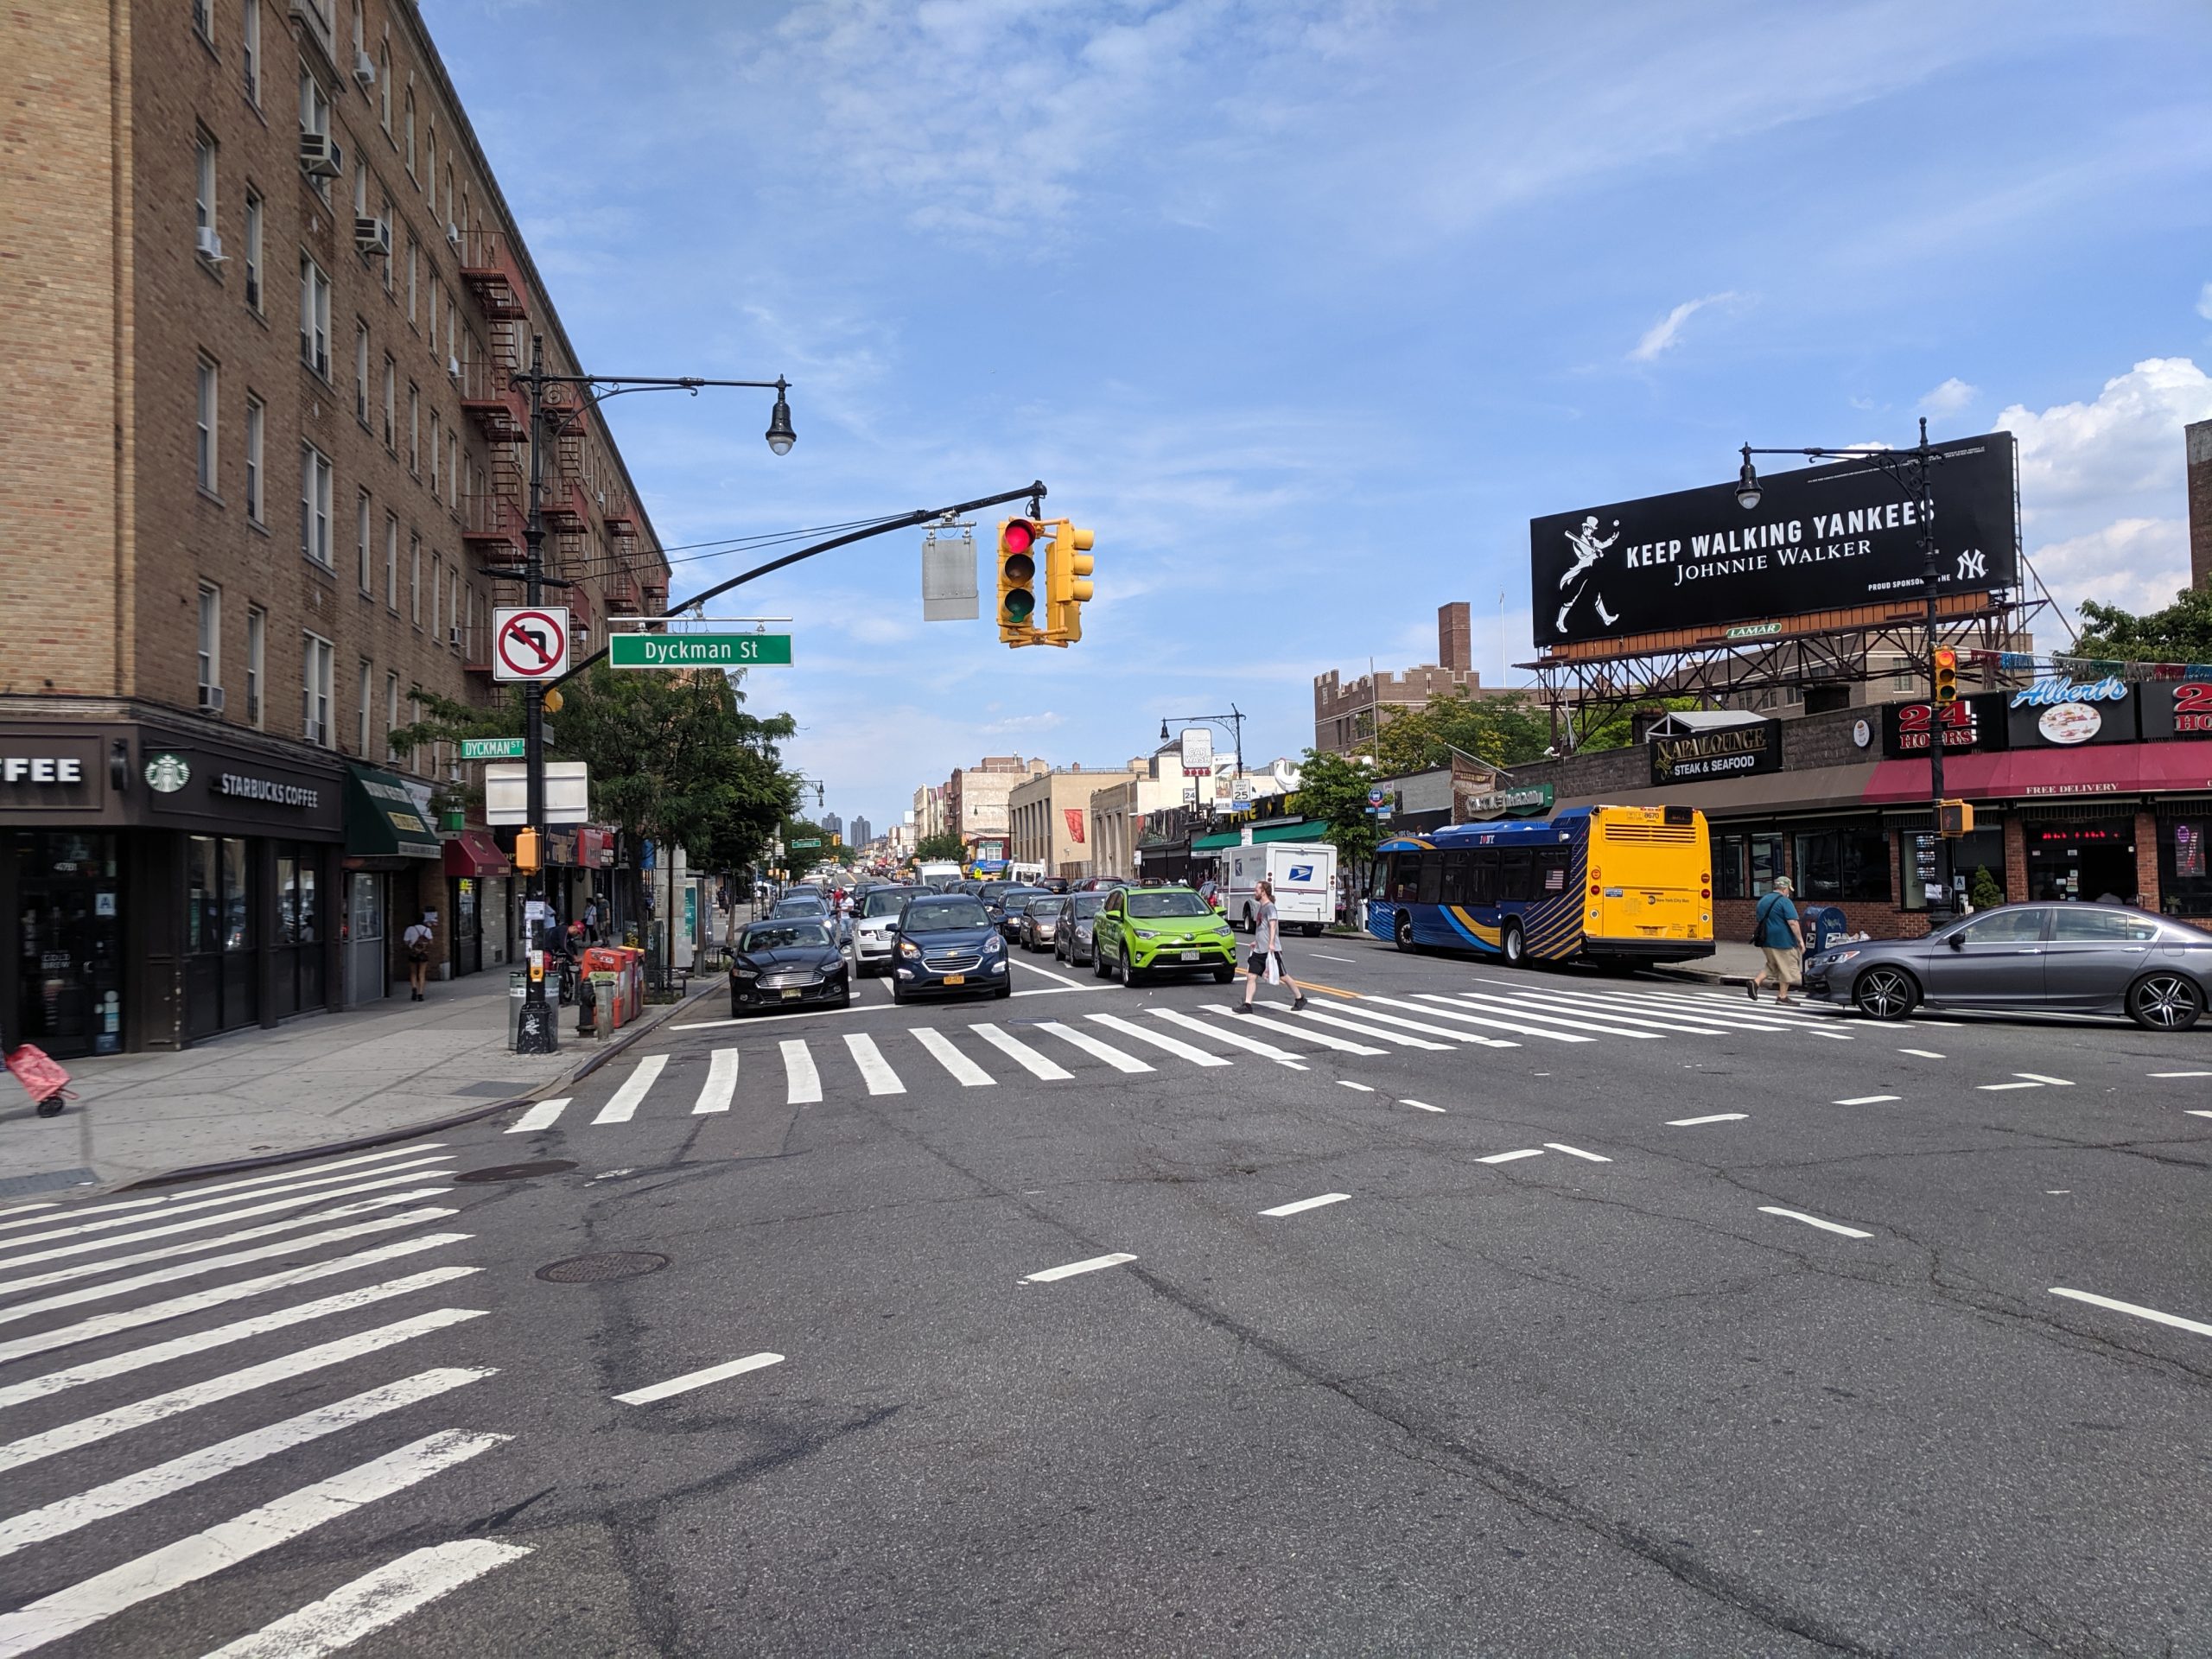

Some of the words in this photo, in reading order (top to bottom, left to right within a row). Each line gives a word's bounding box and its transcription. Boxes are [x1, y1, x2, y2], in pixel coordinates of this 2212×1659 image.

[1626, 539, 1681, 569] KEEP
[1692, 520, 1802, 557] WALKING
[1813, 499, 1936, 539] YANKEES
[1674, 555, 1768, 586] JOHNNIE
[1777, 539, 1872, 566] WALKER
[1957, 549, 1987, 581] NY
[1868, 582, 1891, 592] PROUD
[1730, 624, 1777, 636] LAMAR
[645, 641, 732, 664] Dyckman
[740, 641, 759, 658] St
[2010, 675, 2128, 709] Albert's
[1899, 701, 1974, 732] 24
[465, 741, 510, 757] DYCKMAN
[510, 741, 521, 749] ST
[1900, 728, 1976, 749] HORS
[1674, 763, 1701, 776] STEAK
[1702, 762, 1709, 772] &
[1711, 755, 1755, 772] SEAFOOD
[221, 772, 284, 804] STARBUCKS
[285, 785, 318, 808] COFFEE
[1234, 791, 1249, 800] 25
[2025, 785, 2056, 794] FREE
[2059, 782, 2120, 793] DELIVERY
